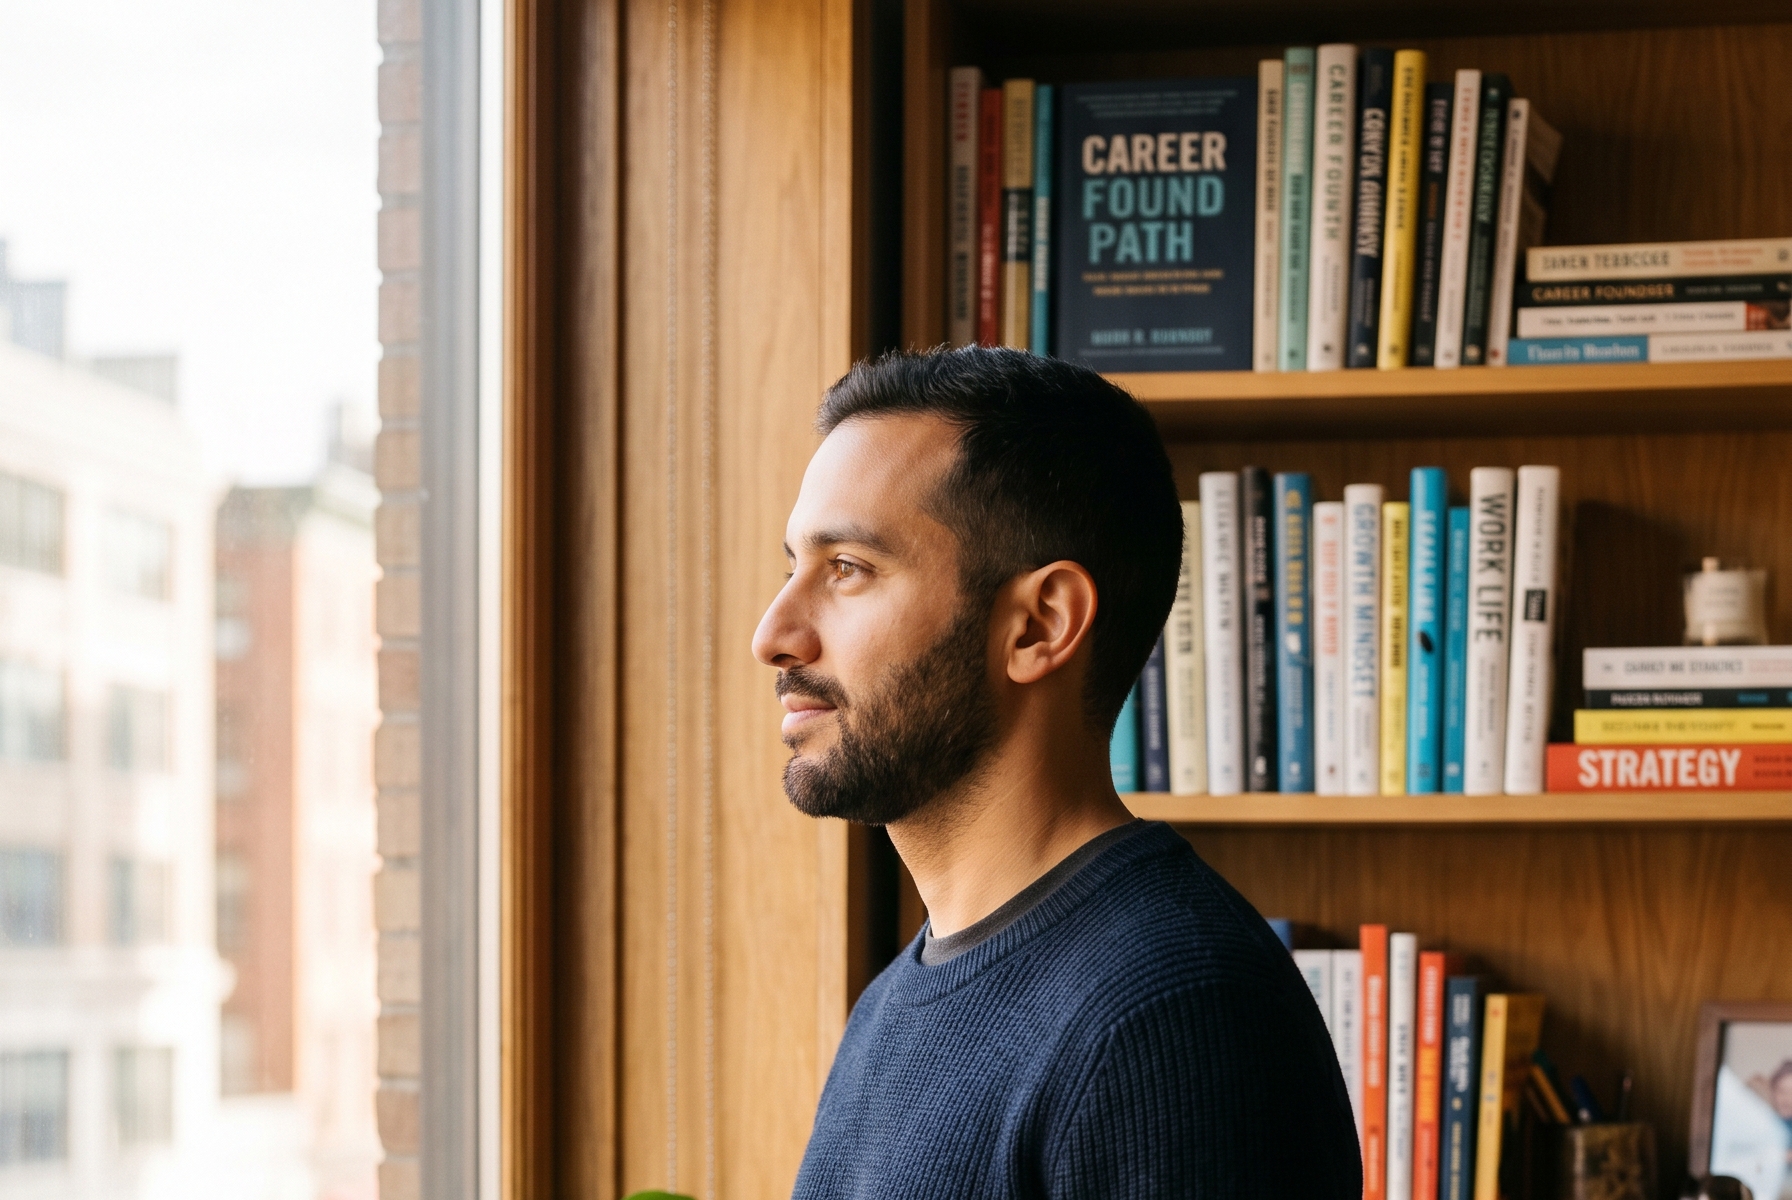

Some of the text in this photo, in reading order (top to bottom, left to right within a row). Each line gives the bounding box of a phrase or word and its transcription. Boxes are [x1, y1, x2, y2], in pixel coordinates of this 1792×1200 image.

[1327, 63, 1346, 146] CAREER
[1082, 131, 1227, 174] CAREER
[1082, 175, 1225, 221] FOUND
[1088, 221, 1194, 264] PATH
[1531, 285, 1591, 302] CAREER
[1475, 493, 1507, 644] WORK LIFE
[1352, 503, 1377, 699] GROWTH MINDSET
[1578, 748, 1741, 788] STRATEGY
